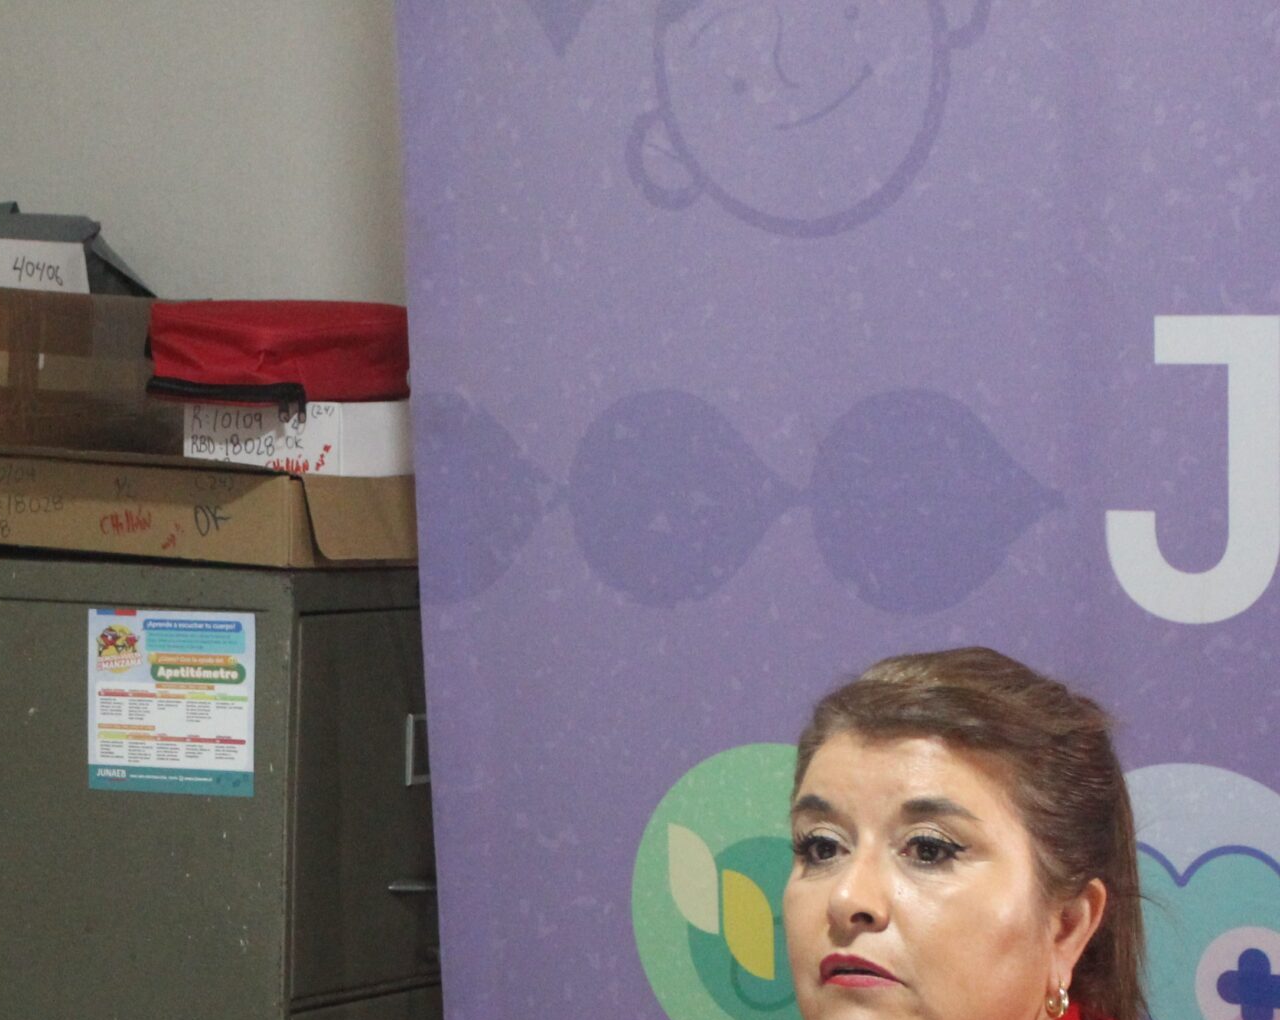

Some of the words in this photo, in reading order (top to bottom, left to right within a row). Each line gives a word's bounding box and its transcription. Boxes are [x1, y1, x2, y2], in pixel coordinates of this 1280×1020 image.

[12, 256, 64, 286] 40406
[194, 504, 232, 537] OK
[157, 665, 239, 680] Apetitómetro
[96, 768, 127, 778] JUNAEB
